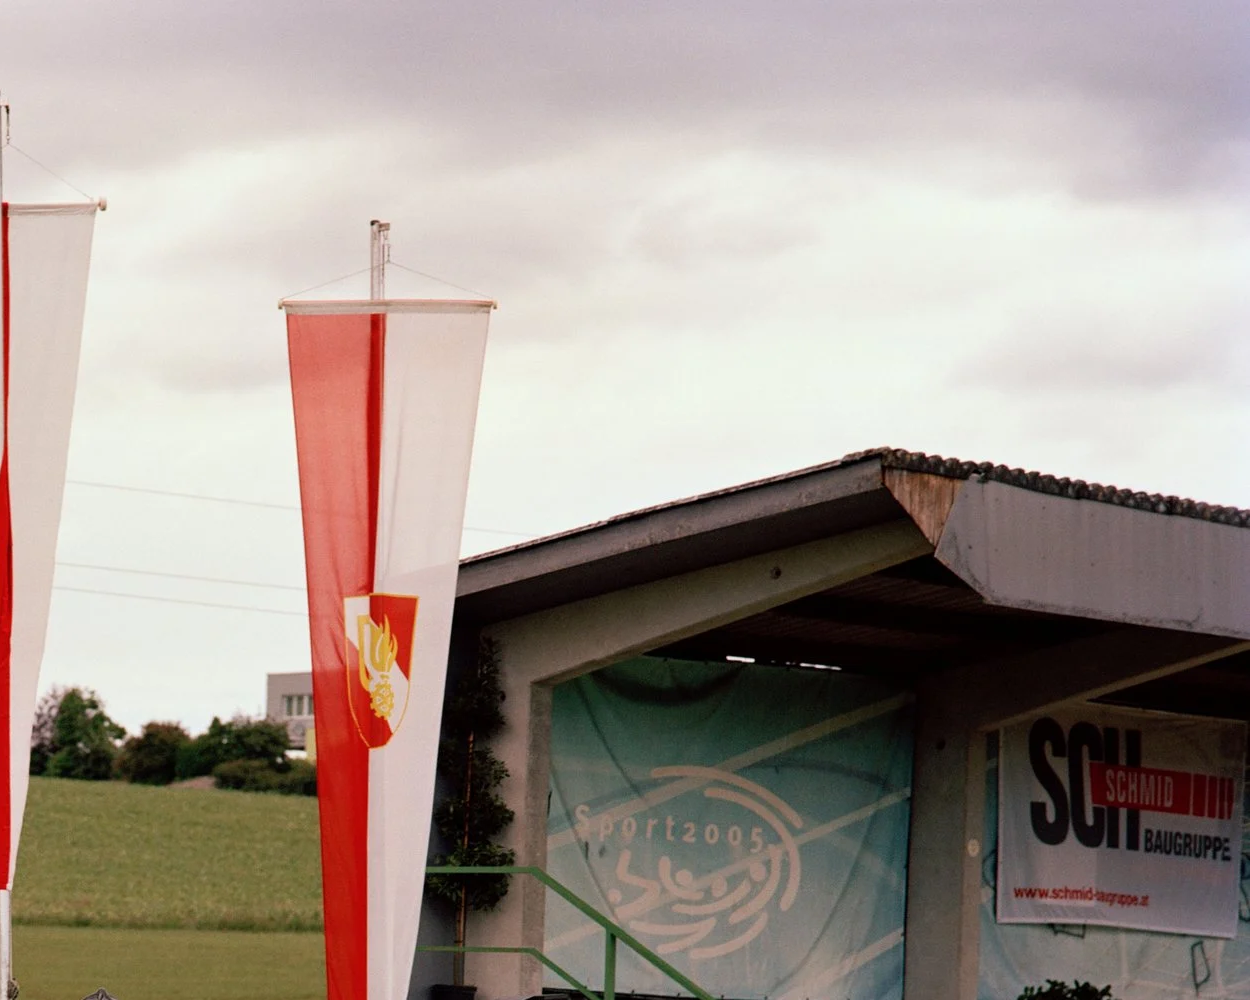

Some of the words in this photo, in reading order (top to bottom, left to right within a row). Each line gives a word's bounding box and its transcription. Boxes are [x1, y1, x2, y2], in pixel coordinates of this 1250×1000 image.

[1028, 717, 1141, 851] SCH
[1105, 768, 1174, 808] SCHMID
[1144, 828, 1232, 862] BAUGRUPPE
